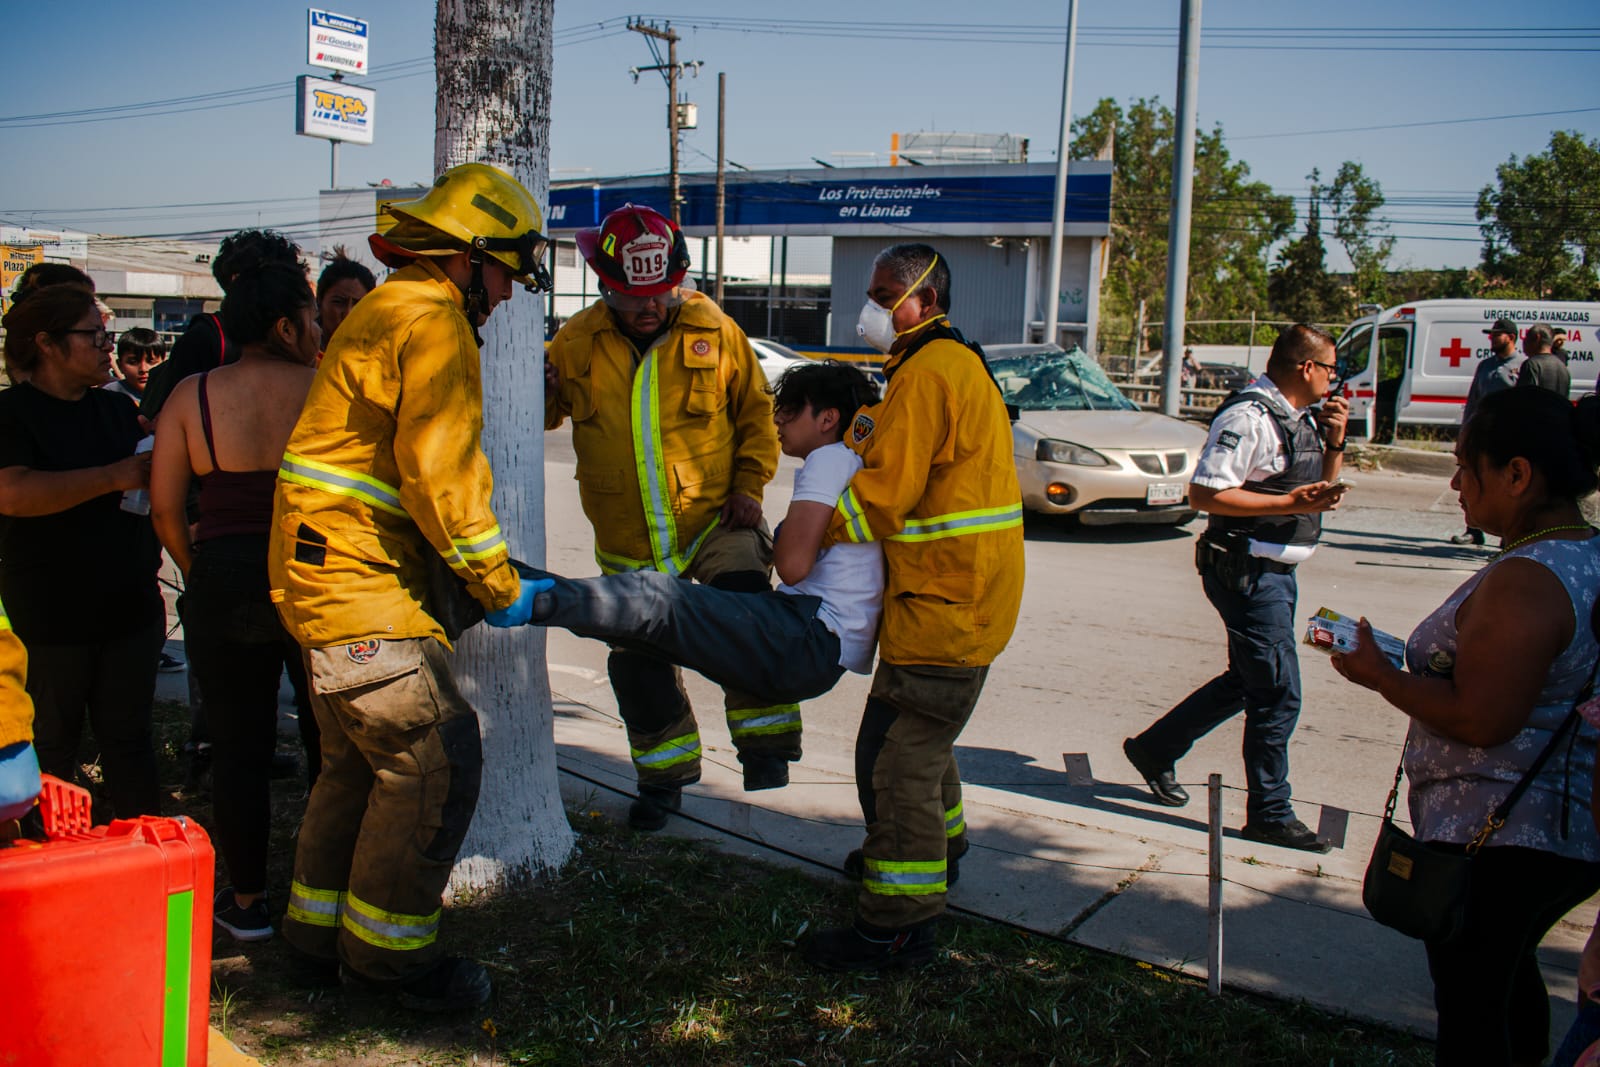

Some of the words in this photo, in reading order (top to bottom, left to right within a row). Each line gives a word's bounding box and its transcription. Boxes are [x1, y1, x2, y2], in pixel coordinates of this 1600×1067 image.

[329, 19, 363, 31] MICHELIN
[317, 34, 363, 49] BFGoodrich
[323, 54, 355, 66] UNIROYAL
[313, 89, 368, 121] TERSA
[818, 187, 843, 200] Los
[845, 184, 943, 200] Profesionales
[839, 206, 857, 217] en
[4, 261, 24, 272] Plaza
[631, 253, 663, 274] 019
[1483, 309, 1538, 320] URGENCIAS
[1539, 311, 1590, 322] AVANZADAS
